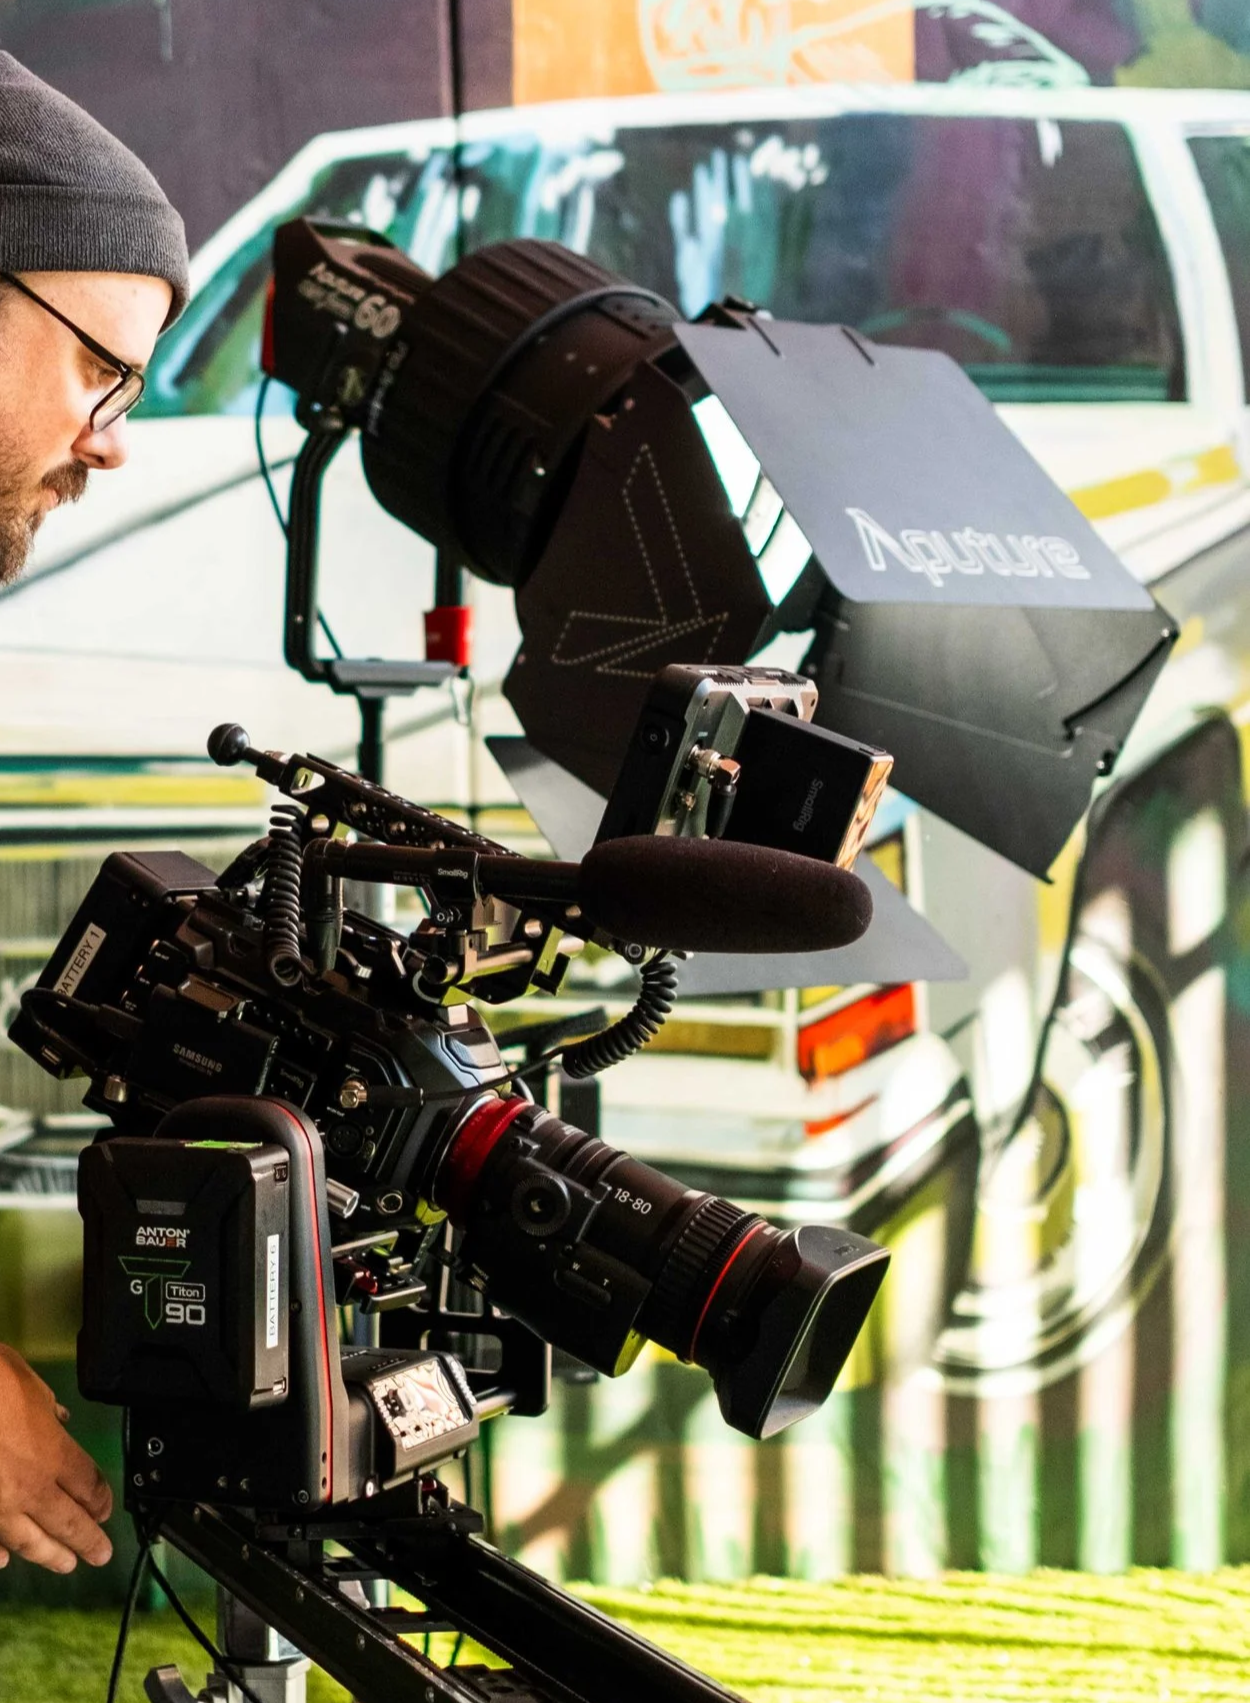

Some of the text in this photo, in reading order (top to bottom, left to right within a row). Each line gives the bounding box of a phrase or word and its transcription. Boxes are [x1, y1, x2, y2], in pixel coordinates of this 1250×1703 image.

[352, 293, 402, 339] 60
[845, 507, 1091, 587] Aputure
[792, 778, 824, 833] SmallRig
[437, 867, 469, 880] SmallRig
[90, 930, 100, 939] 1
[172, 1042, 224, 1074] SAMSUNG
[614, 1187, 652, 1216] 18-80
[135, 1236, 187, 1249] BAUER
[130, 1278, 143, 1295] G
[170, 1286, 200, 1298] Titon
[269, 1260, 277, 1337] BATTERY
[165, 1302, 206, 1326] 90
